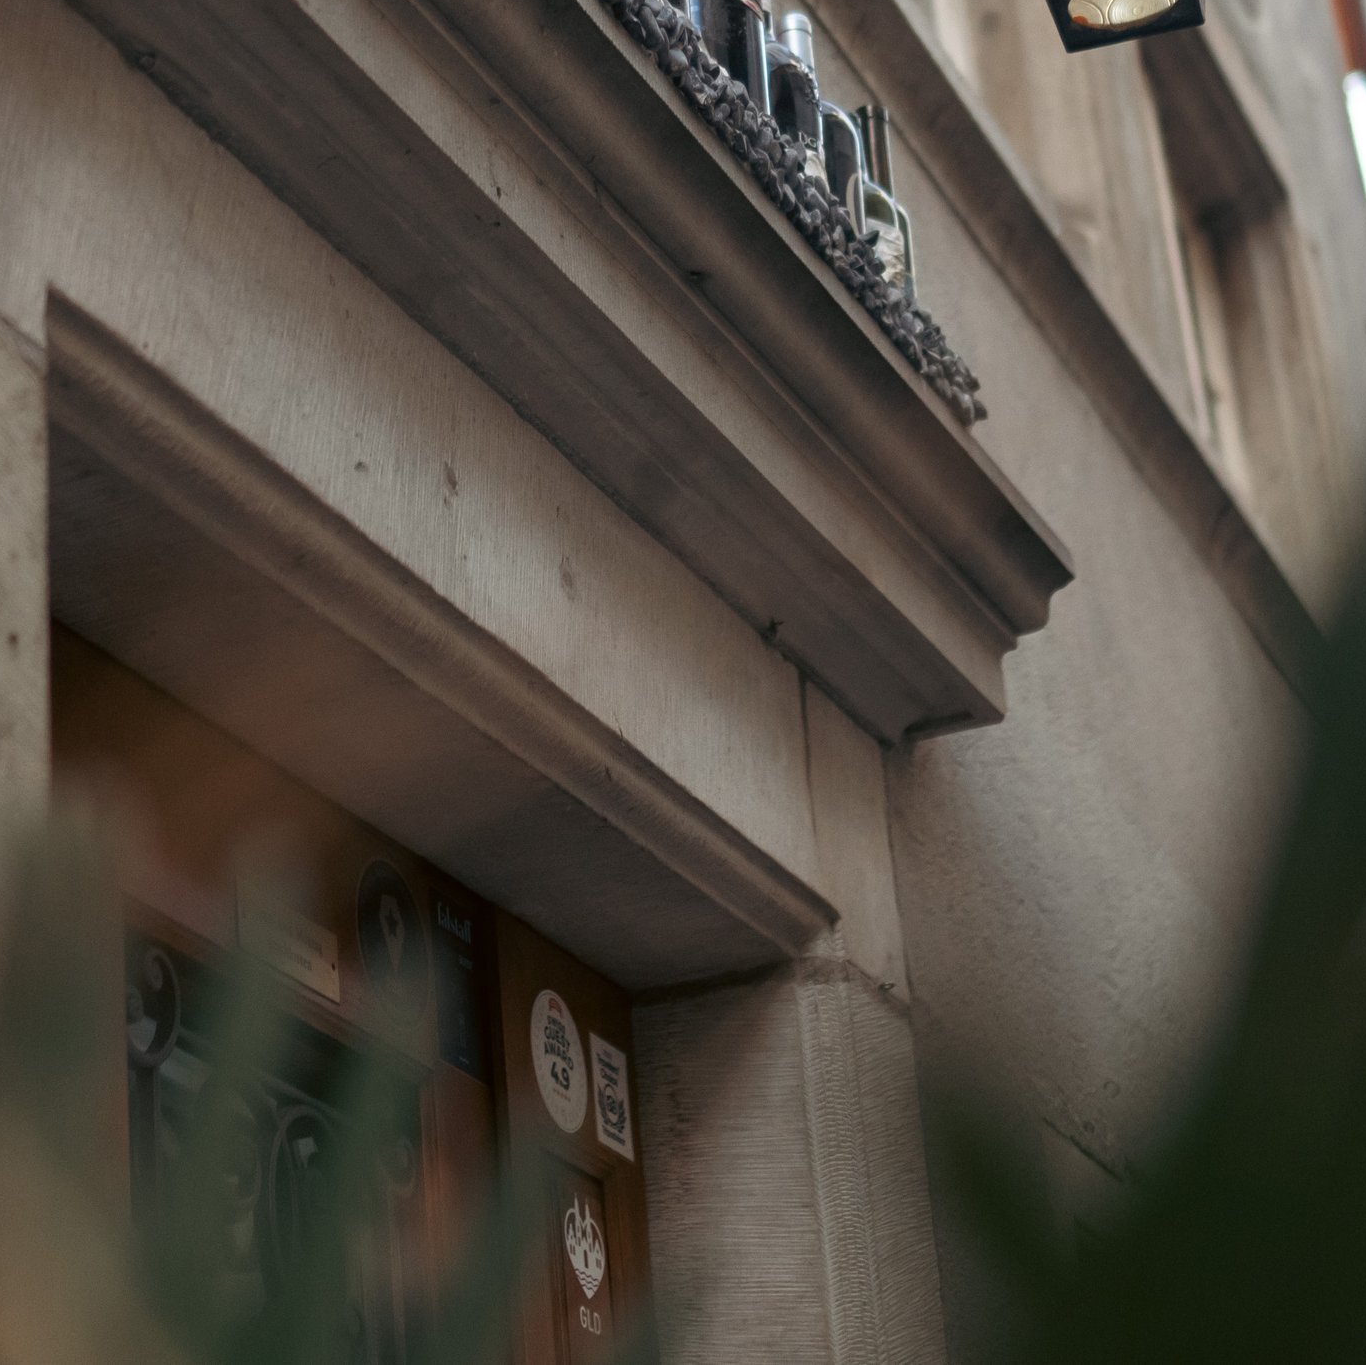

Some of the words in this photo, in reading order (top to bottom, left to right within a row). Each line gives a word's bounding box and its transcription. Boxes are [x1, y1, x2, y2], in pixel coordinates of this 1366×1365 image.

[544, 1025, 570, 1052] GUEST
[544, 1041, 574, 1071] AWARD
[579, 1305, 601, 1335] GLD
